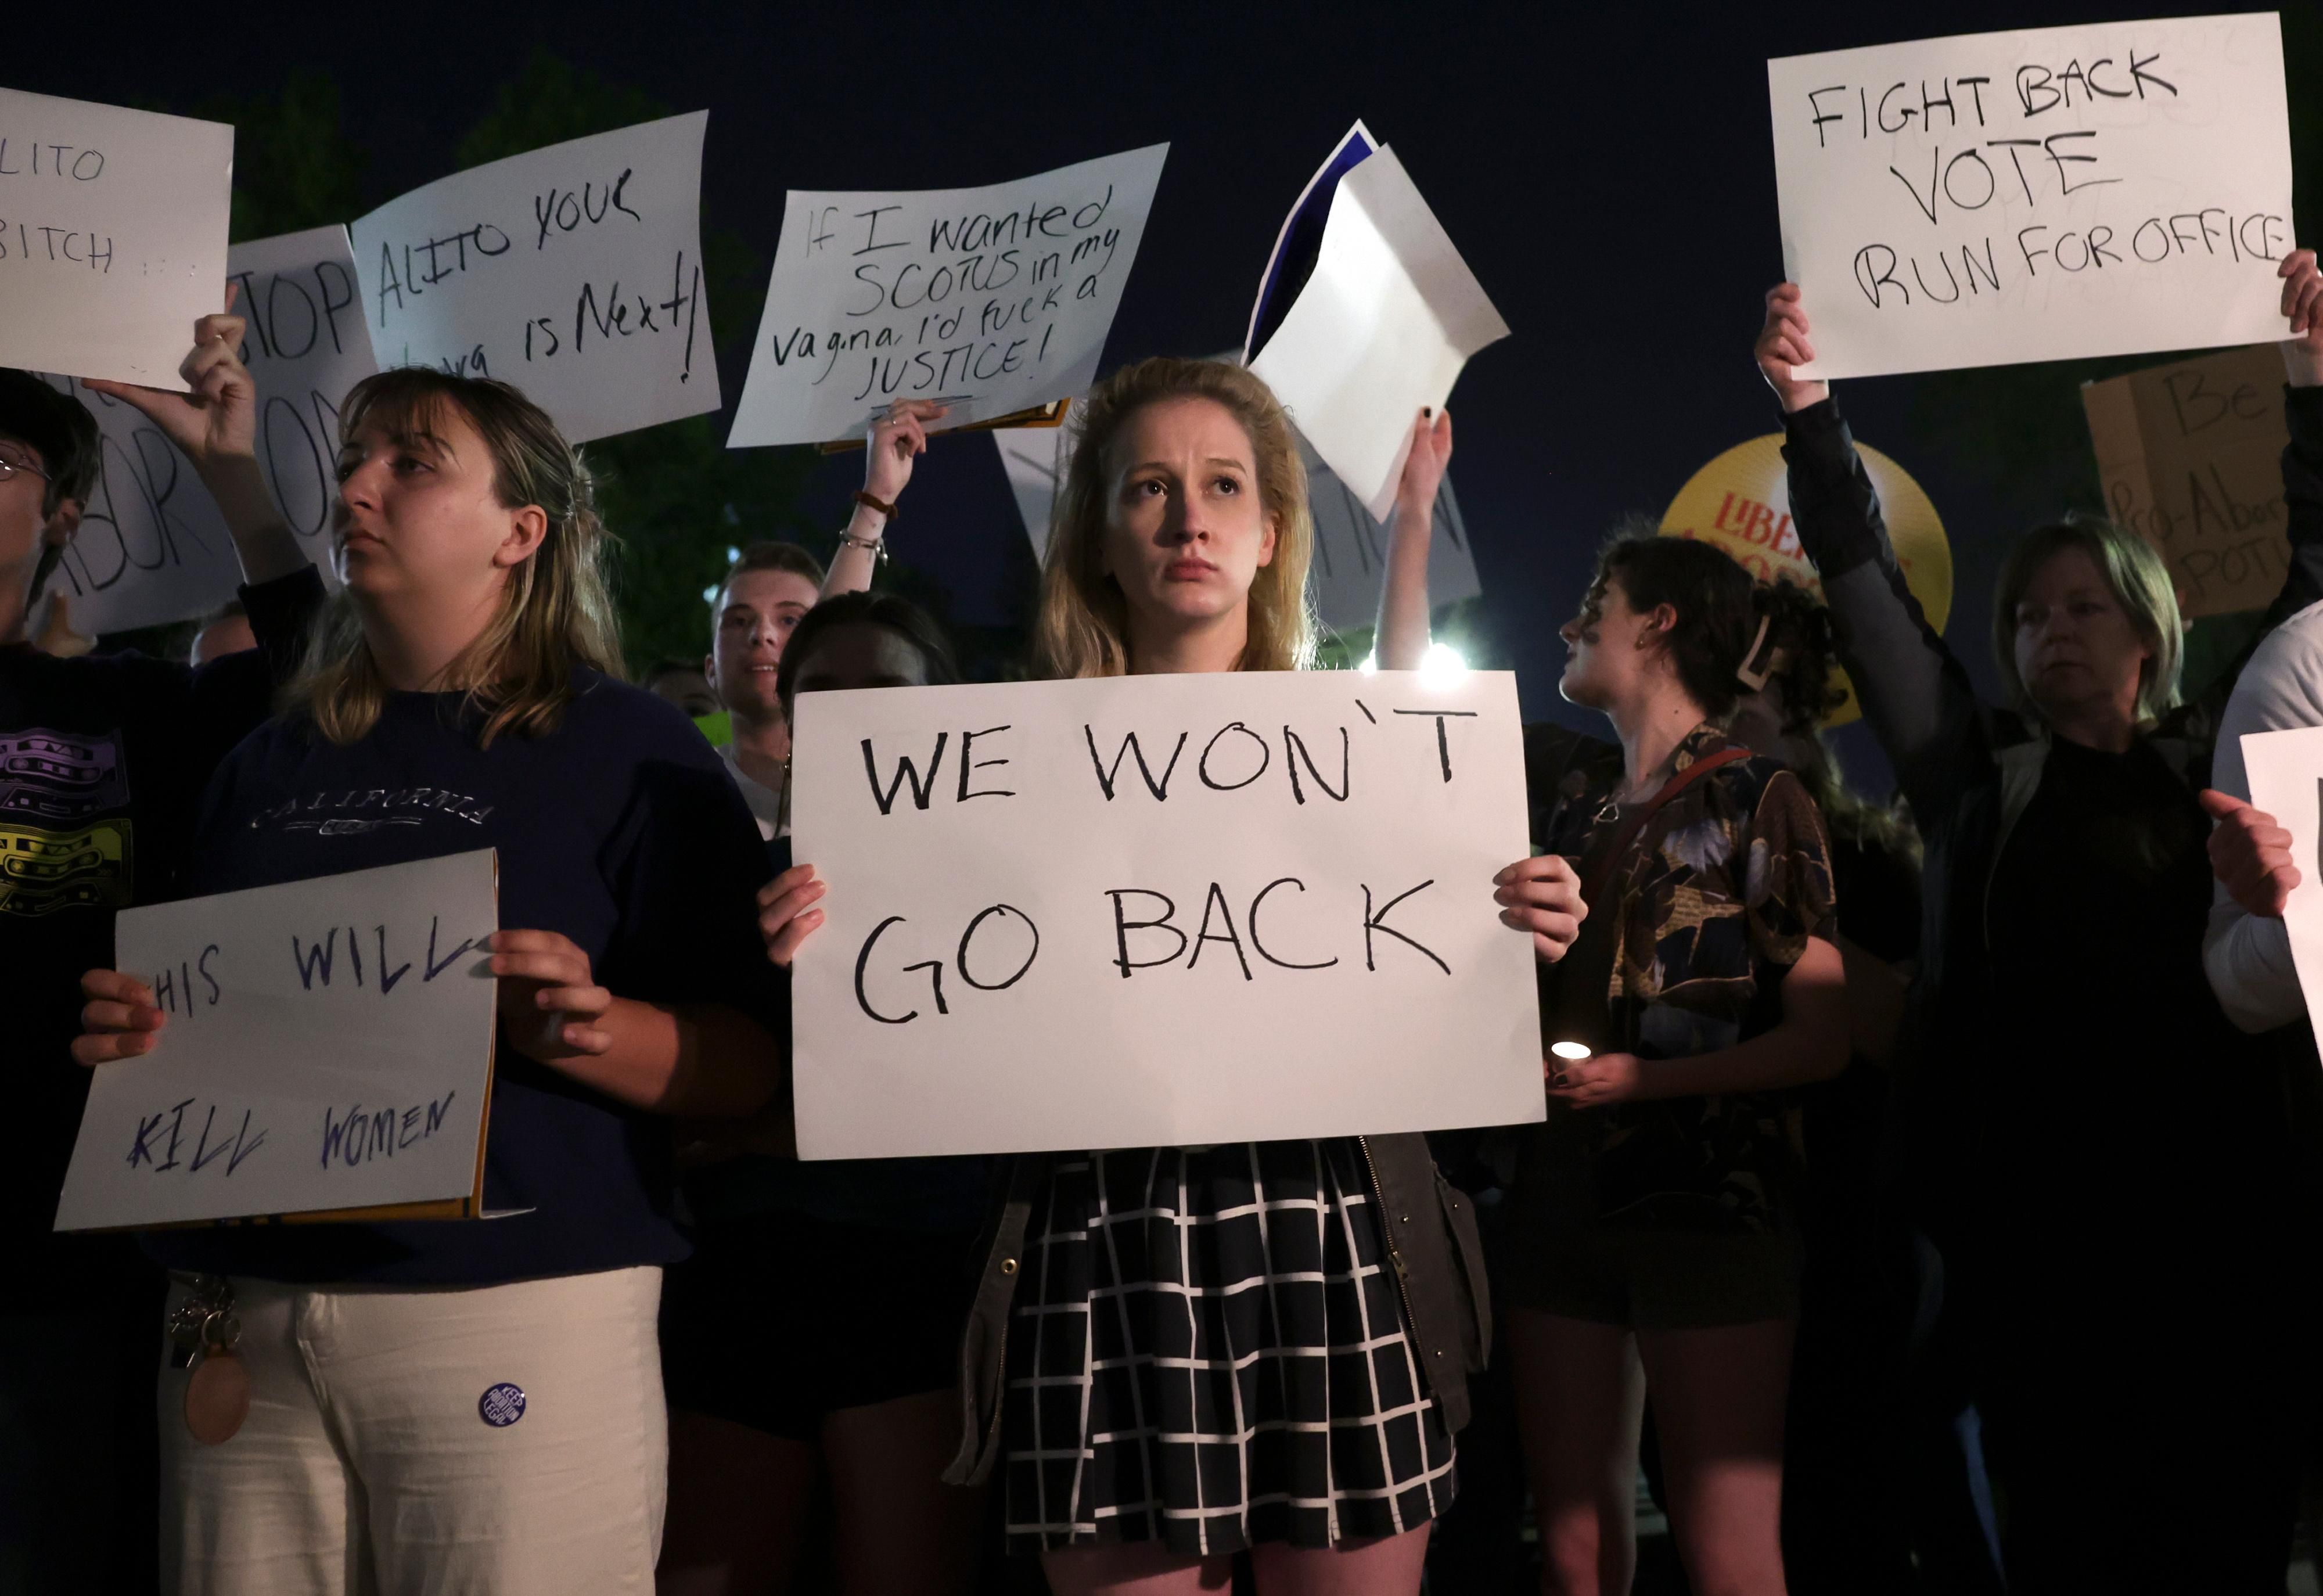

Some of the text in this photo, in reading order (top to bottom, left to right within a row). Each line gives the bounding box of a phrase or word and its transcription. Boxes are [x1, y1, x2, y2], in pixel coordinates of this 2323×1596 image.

[1808, 49, 2178, 147] FIGHT BACK
[1890, 131, 2123, 225] VOTE
[807, 207, 839, 258] If
[853, 206, 911, 256] I
[847, 229, 1120, 316] SCOTUS in my
[1854, 209, 2284, 308] RUN FOR OFFICE
[227, 261, 353, 365] TOP
[576, 250, 699, 383] Next!
[1076, 274, 1098, 300] a
[854, 324, 1053, 401] JUSTICE!
[2163, 370, 2267, 436] Be
[1715, 493, 1805, 560] LIBE
[860, 699, 1478, 815] WE WON'T
[292, 915, 477, 995] WILL
[854, 877, 1451, 1024] GO BACK
[127, 1091, 455, 1177] KILL WOMEN
[483, 1398, 506, 1425] LEGAL
[502, 1386, 523, 1407] KEEP
